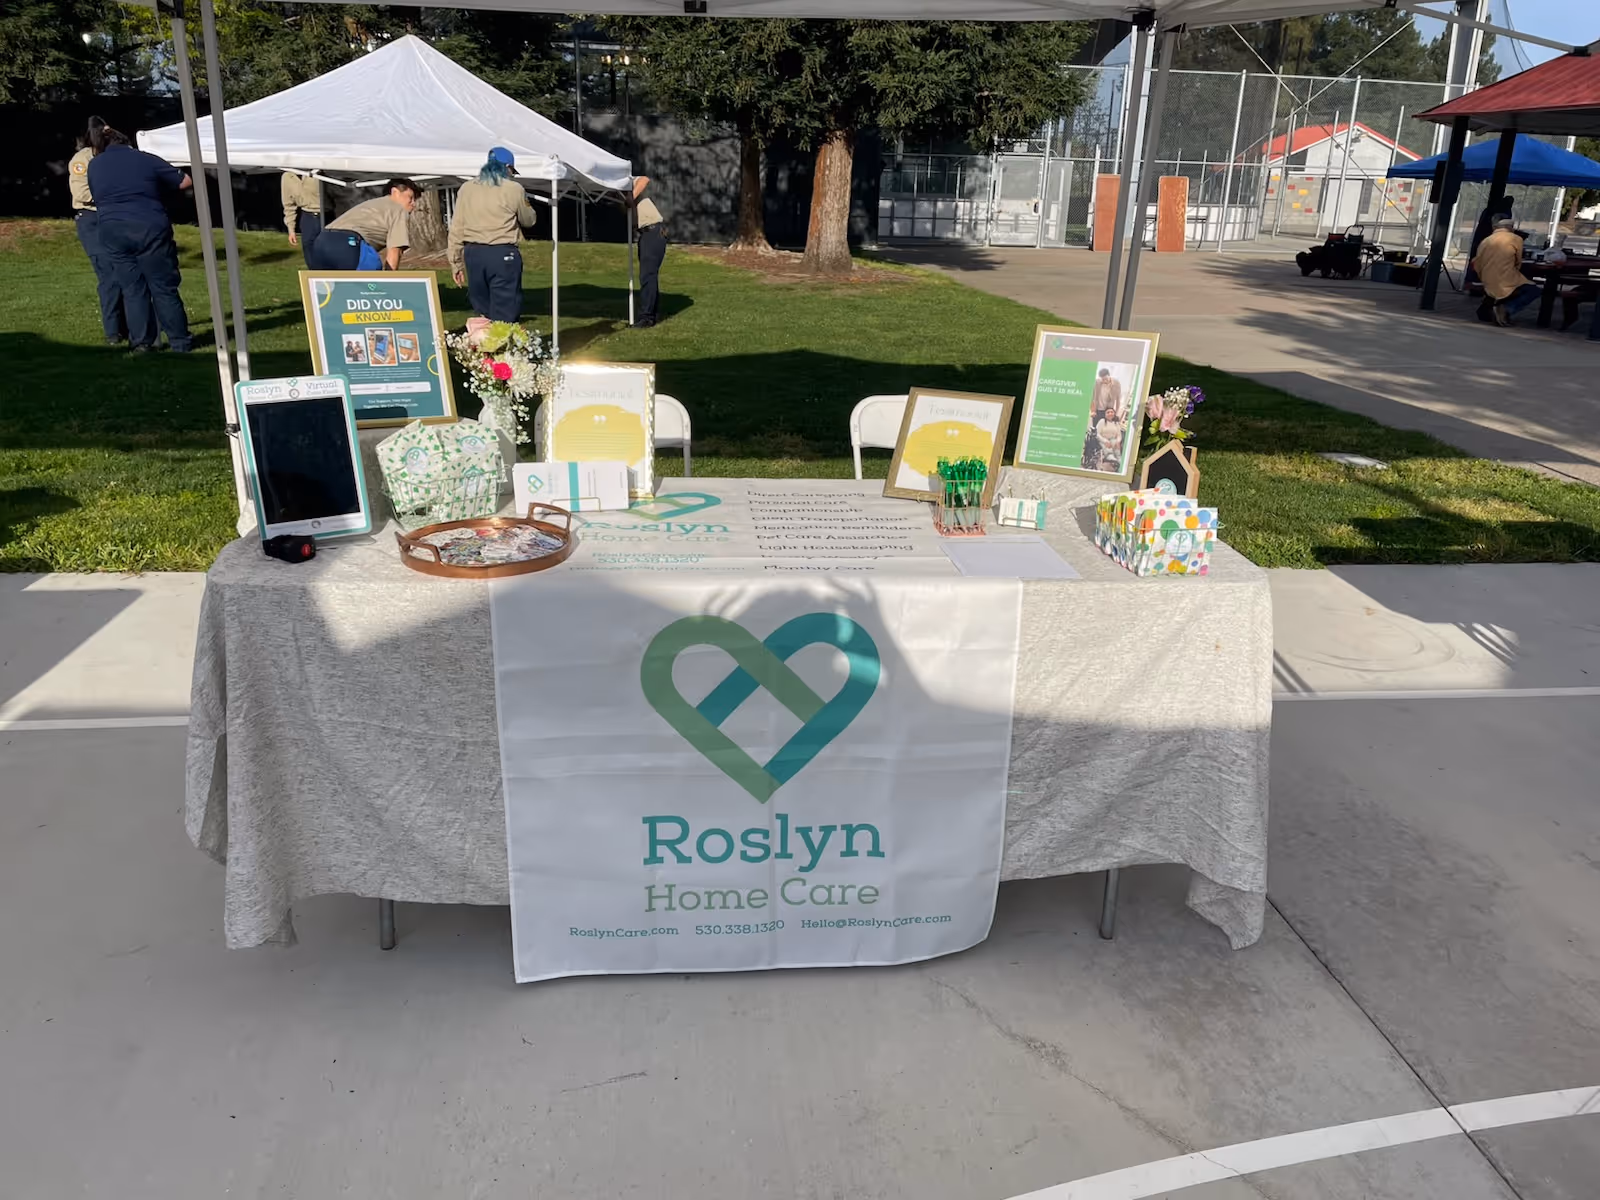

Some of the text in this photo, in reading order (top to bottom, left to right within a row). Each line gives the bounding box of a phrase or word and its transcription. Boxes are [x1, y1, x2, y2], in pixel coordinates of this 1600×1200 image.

[346, 298, 403, 310] DID YOU
[305, 381, 338, 390] Virtual
[580, 531, 731, 543] Home Care
[758, 544, 799, 552] Light
[641, 813, 886, 873] Roslyn
[643, 877, 880, 913] Home Care
[569, 914, 952, 940] RoslynCare.com 530.338.1320 Hello@RoslynCare.com
